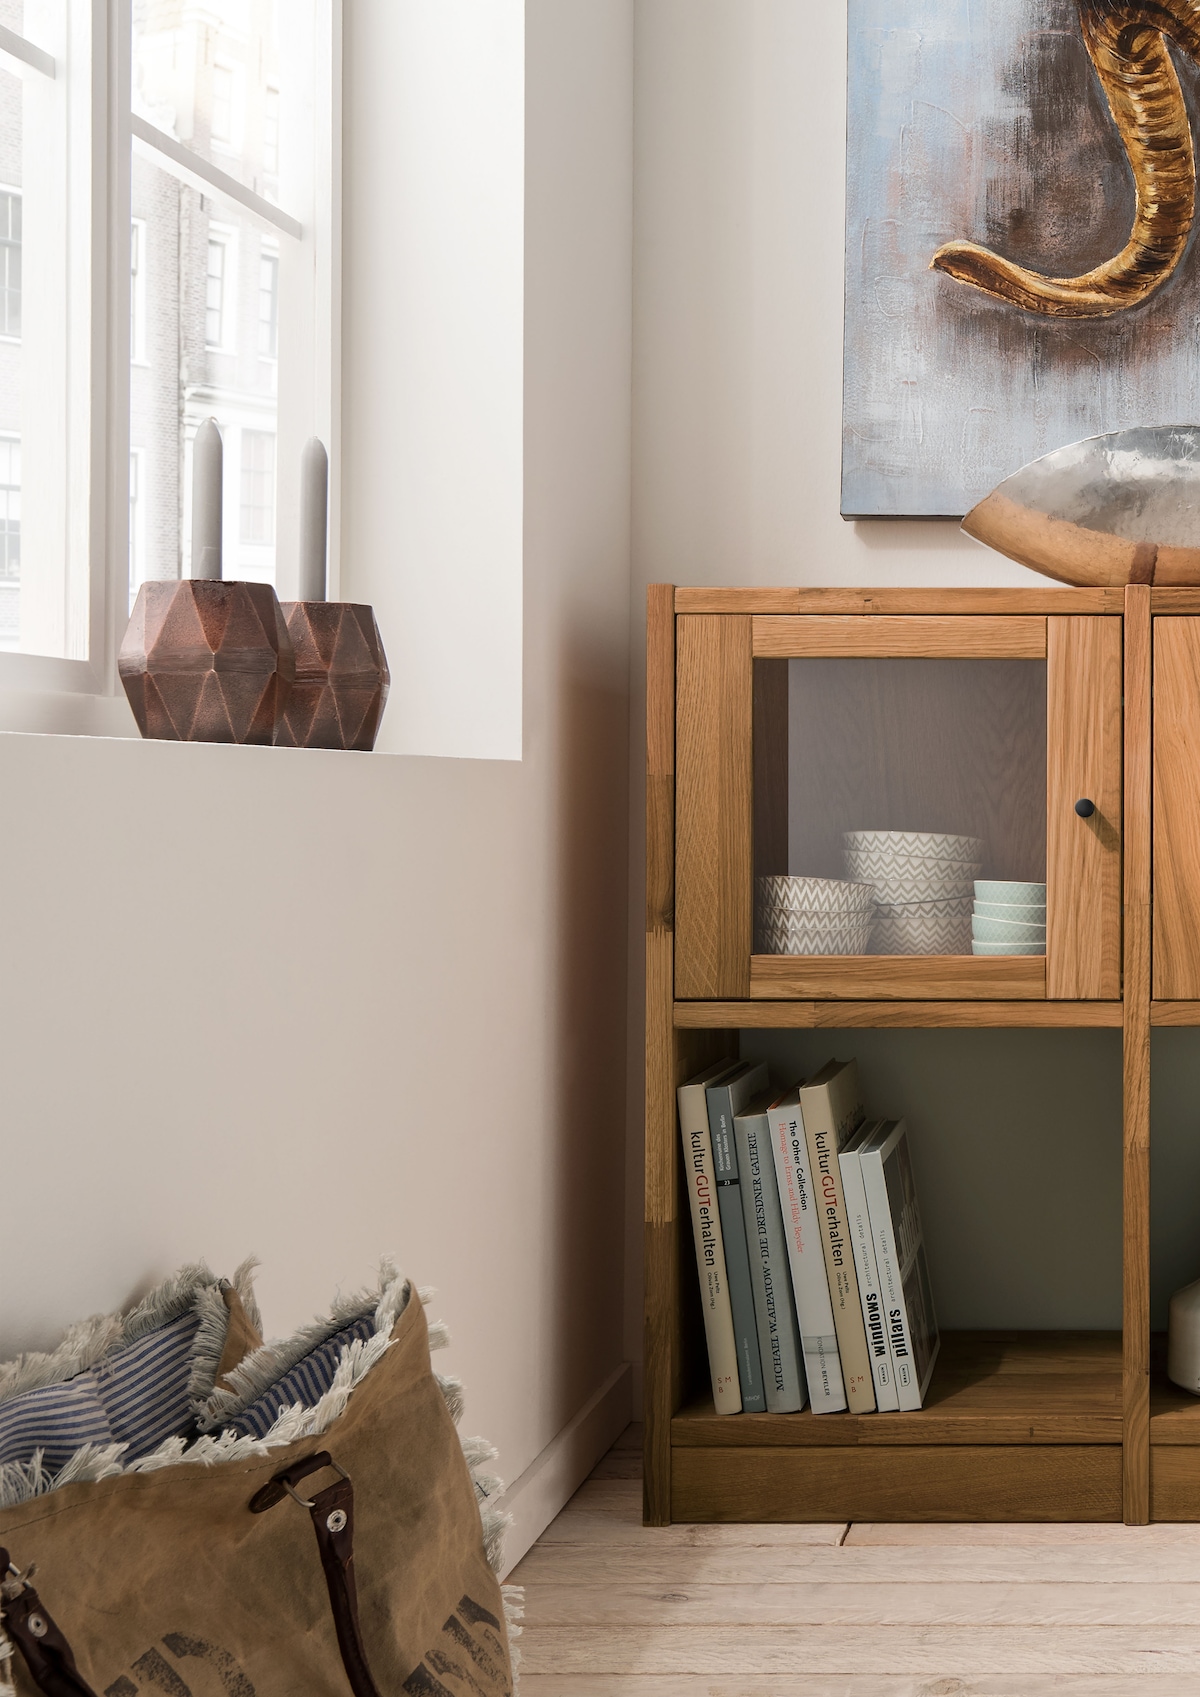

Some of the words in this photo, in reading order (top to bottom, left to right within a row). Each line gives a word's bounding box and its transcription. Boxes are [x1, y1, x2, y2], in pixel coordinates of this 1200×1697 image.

[748, 1132, 760, 1176] GALERIE
[778, 1122, 788, 1154] Homage
[784, 1155, 789, 1164] to
[792, 1140, 801, 1164] Other
[690, 1131, 716, 1266] kulturGUTerhalten
[752, 1178, 767, 1235] DRESDNER
[788, 1188, 798, 1202] and
[796, 1168, 808, 1211] Collection
[814, 1131, 844, 1267] kulturGUTerhalten
[791, 1203, 800, 1224] Hildy
[760, 1238, 769, 1258] DIE
[794, 1226, 805, 1254] Beyeler
[860, 1242, 872, 1286] architectural
[884, 1257, 896, 1302] architectural
[866, 1293, 886, 1357] windows
[890, 1309, 908, 1358] pillars
[770, 1336, 784, 1392] MICHAEL
[822, 1370, 830, 1396] BEYELER
